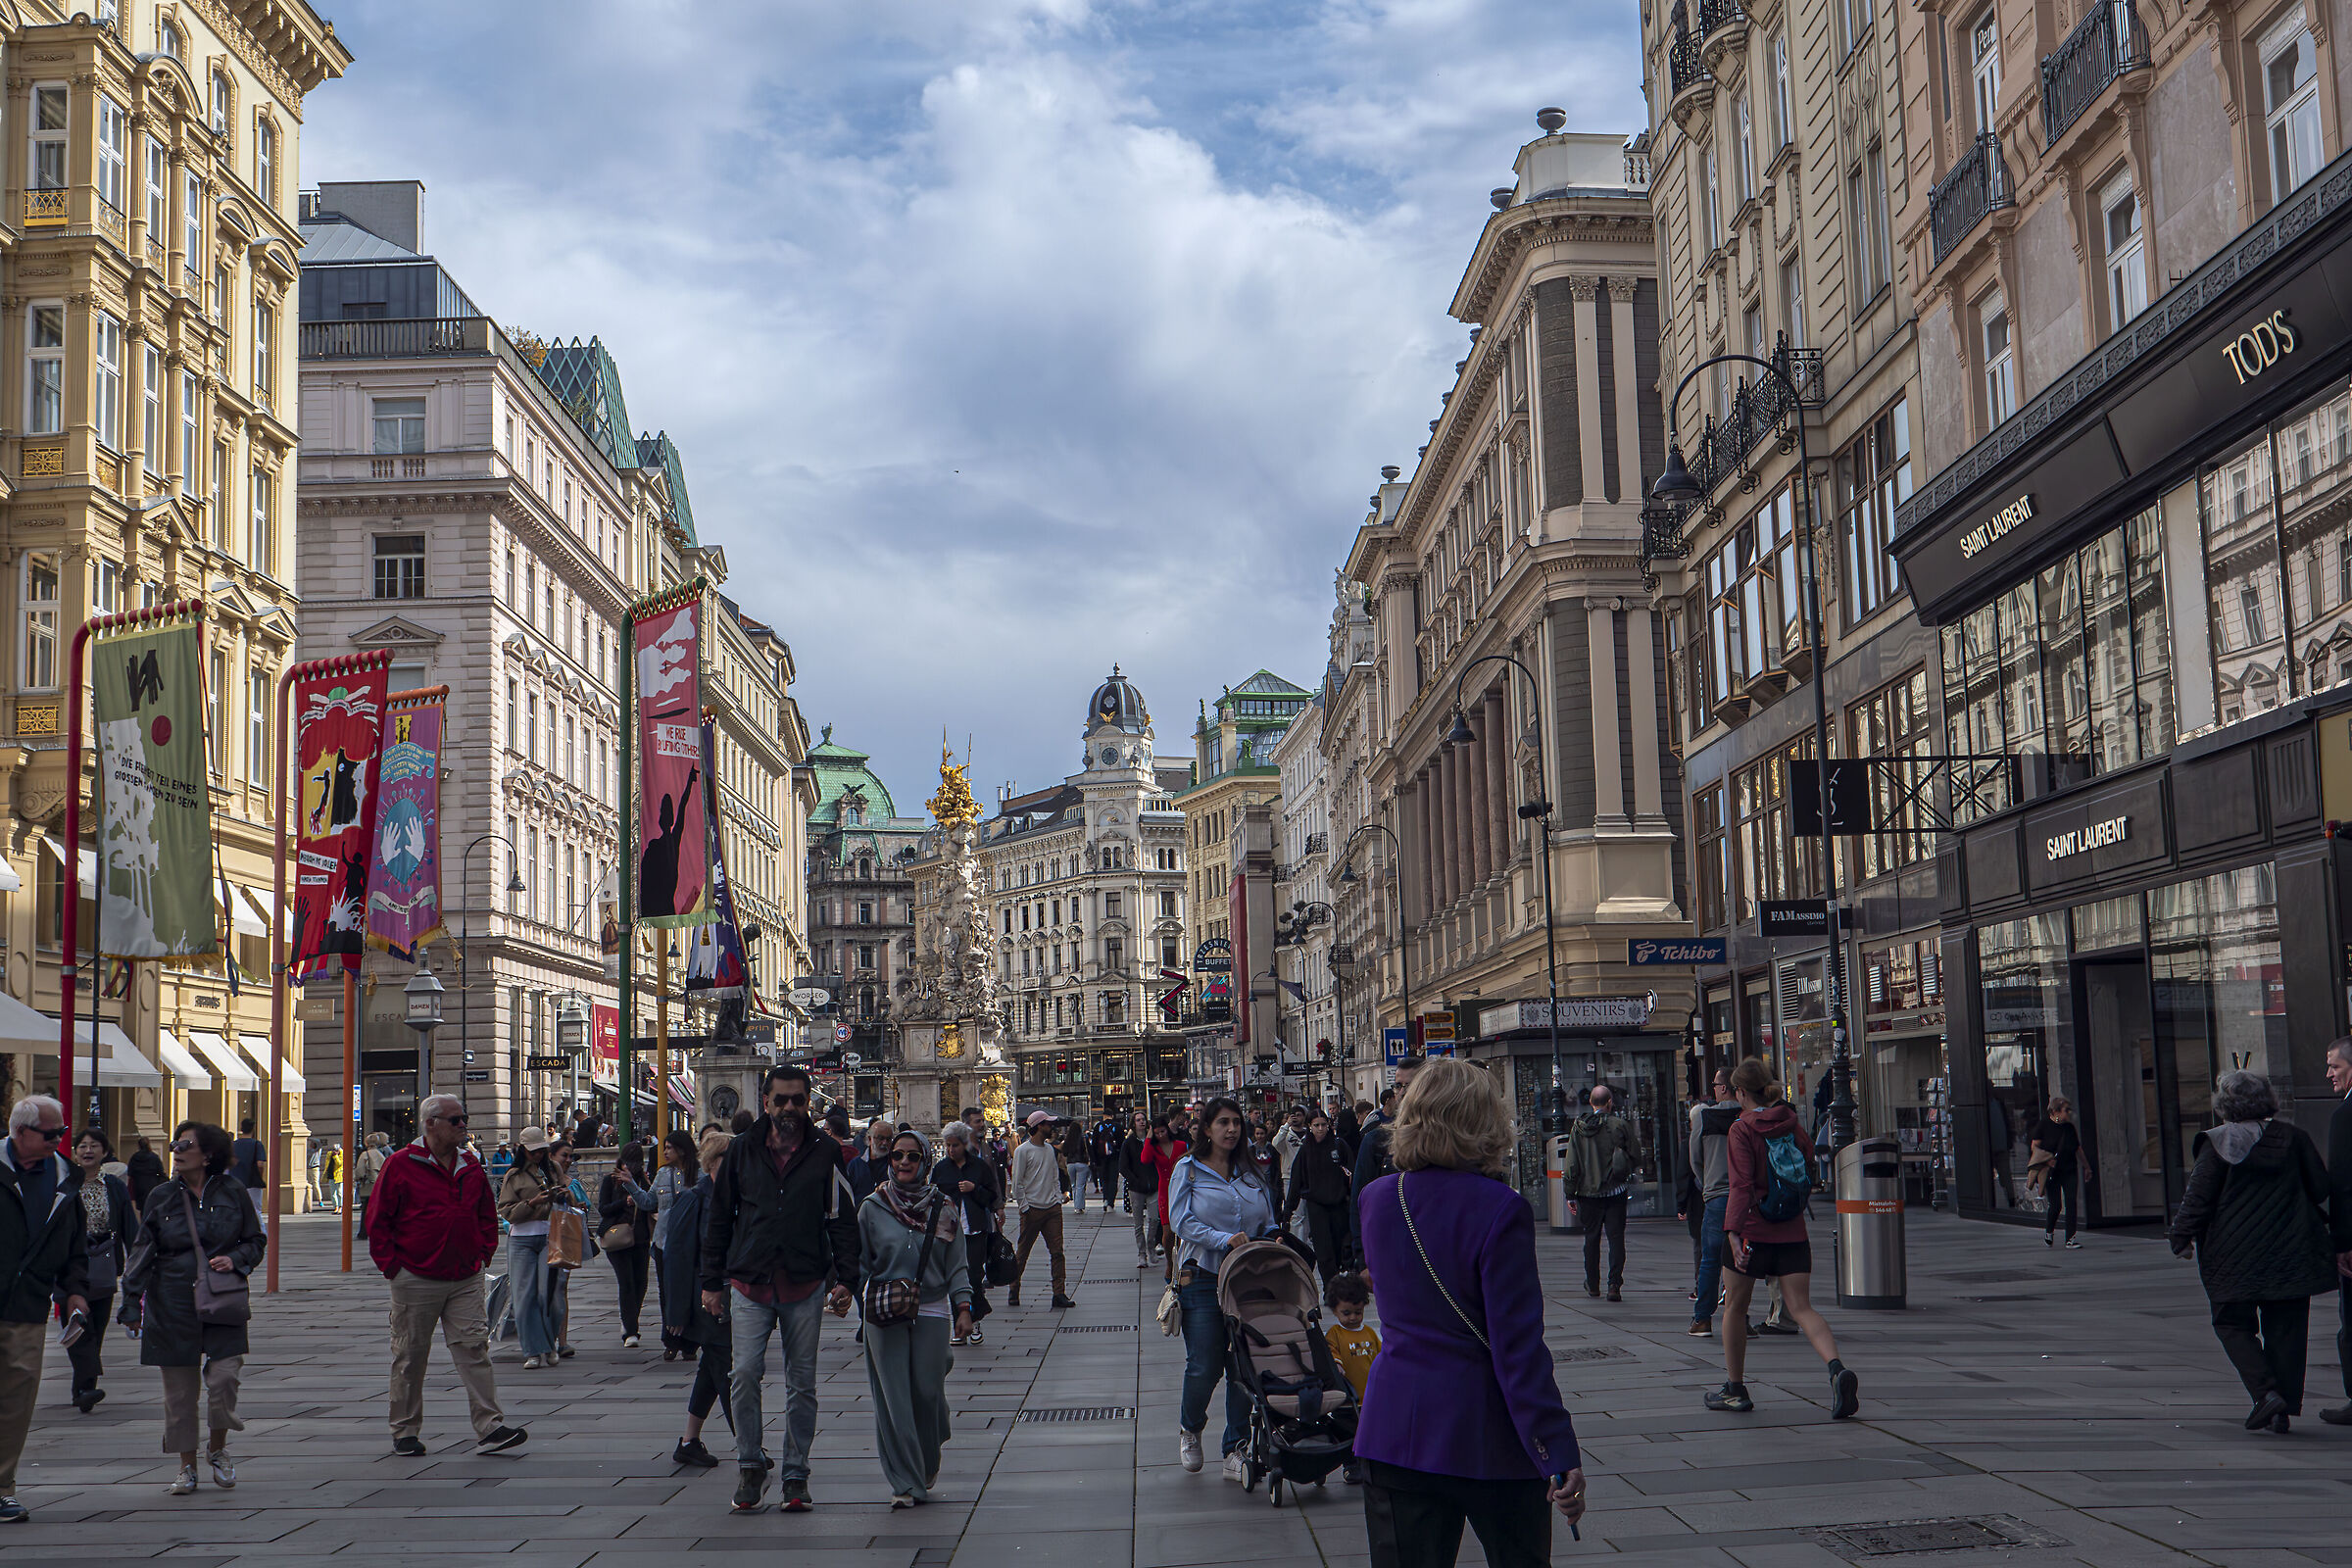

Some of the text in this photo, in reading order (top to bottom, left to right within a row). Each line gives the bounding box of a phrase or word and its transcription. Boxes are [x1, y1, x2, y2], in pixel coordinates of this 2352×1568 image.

[2222, 310, 2294, 384] TOD'S
[1960, 494, 2033, 559] SAINT LAURENT
[121, 757, 133, 769] DIE
[157, 773, 170, 787] TEIL
[172, 778, 198, 795] EINES
[165, 792, 176, 803] ZU
[178, 796, 199, 809] SEIN
[2046, 815, 2127, 860] SAINT LAURENT
[1659, 945, 1721, 960] Tchibo
[374, 1012, 407, 1022] ESCA
[747, 1023, 769, 1032] erin
